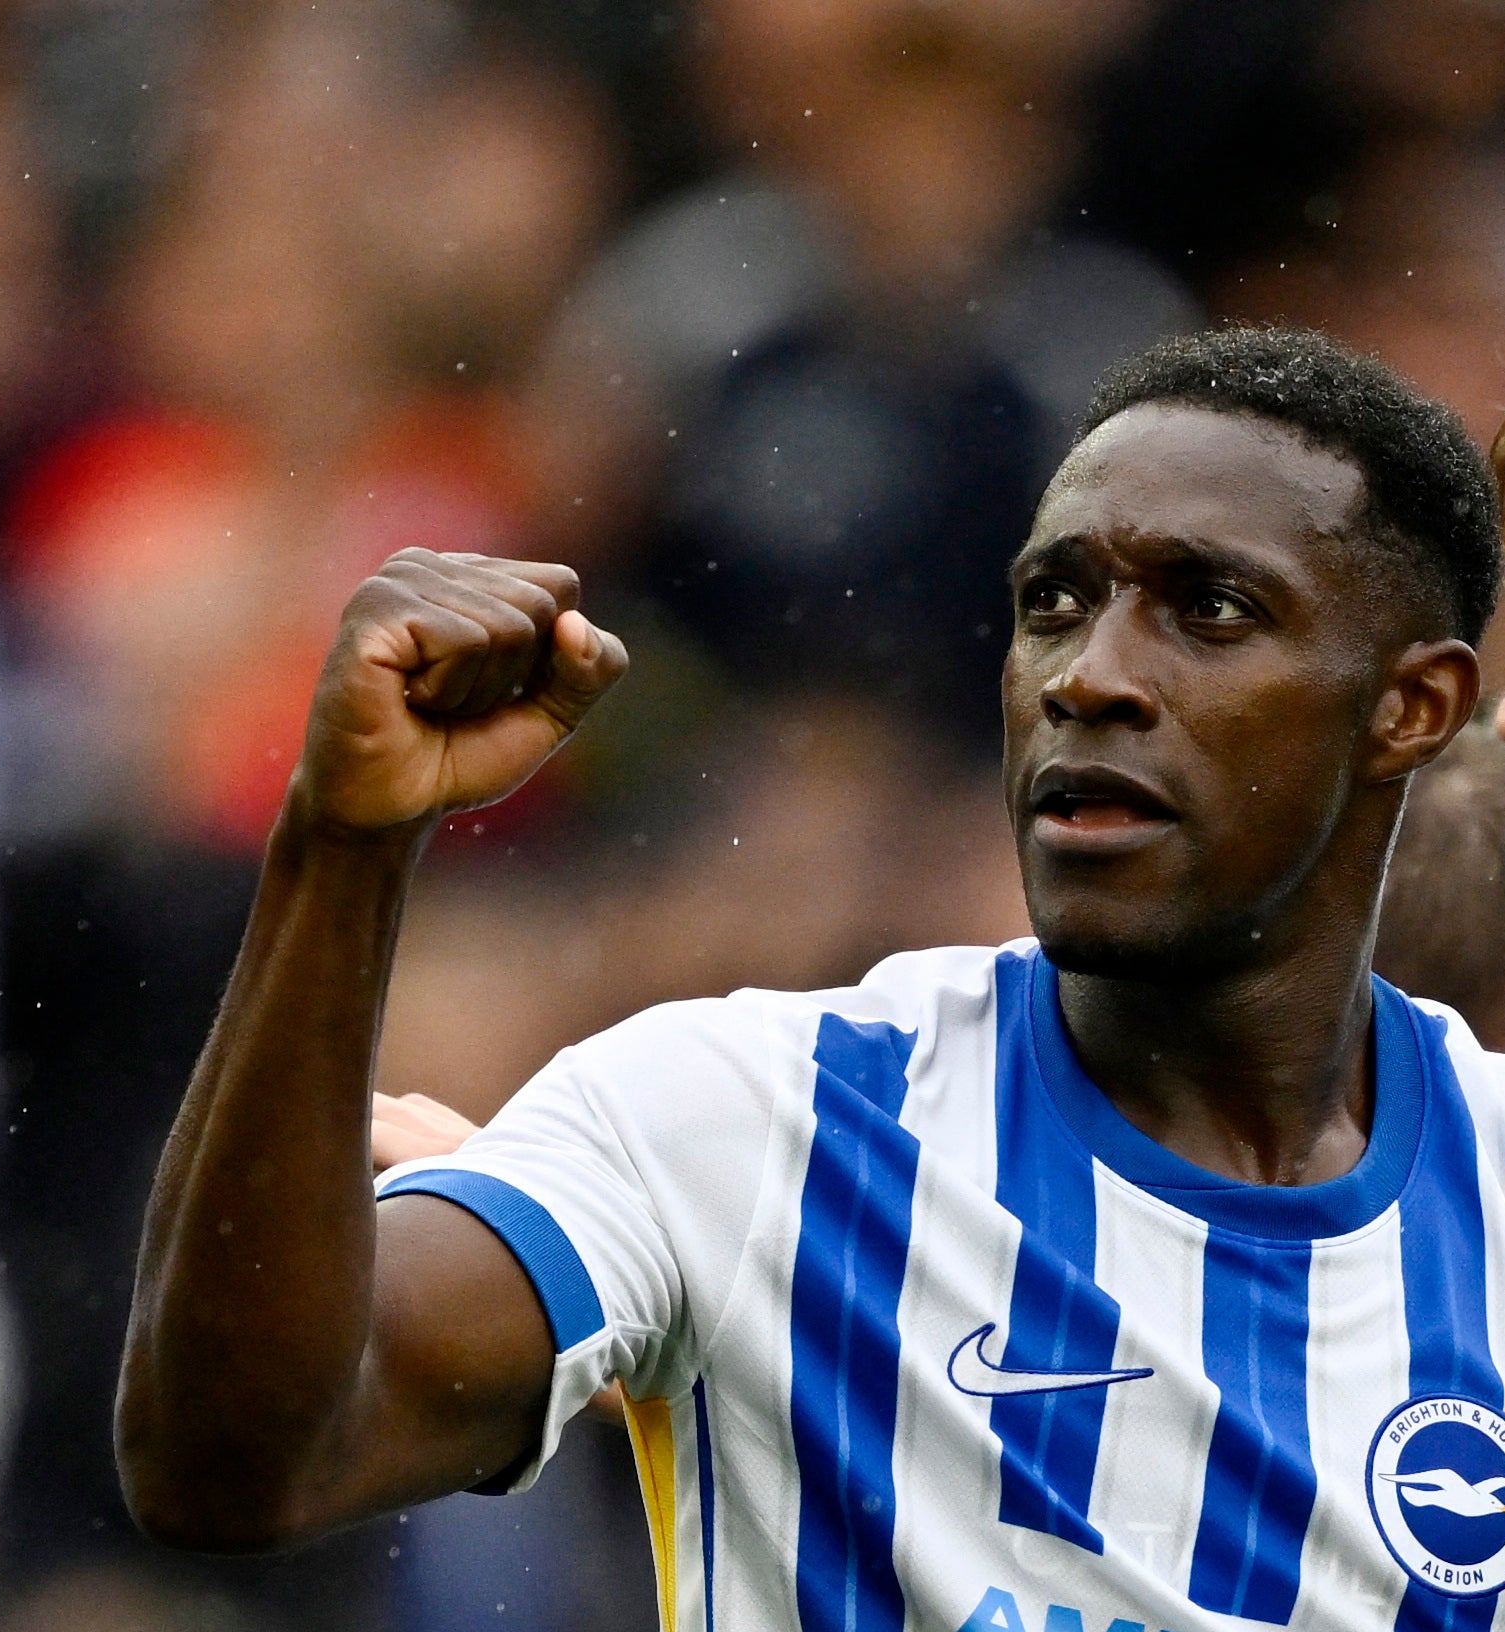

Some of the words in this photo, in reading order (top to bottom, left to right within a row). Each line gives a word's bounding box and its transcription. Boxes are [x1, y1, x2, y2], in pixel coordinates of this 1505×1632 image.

[1389, 1402, 1462, 1444] BRIGHTON
[1471, 1410, 1482, 1423] &
[1421, 1561, 1484, 1585] ALBION
